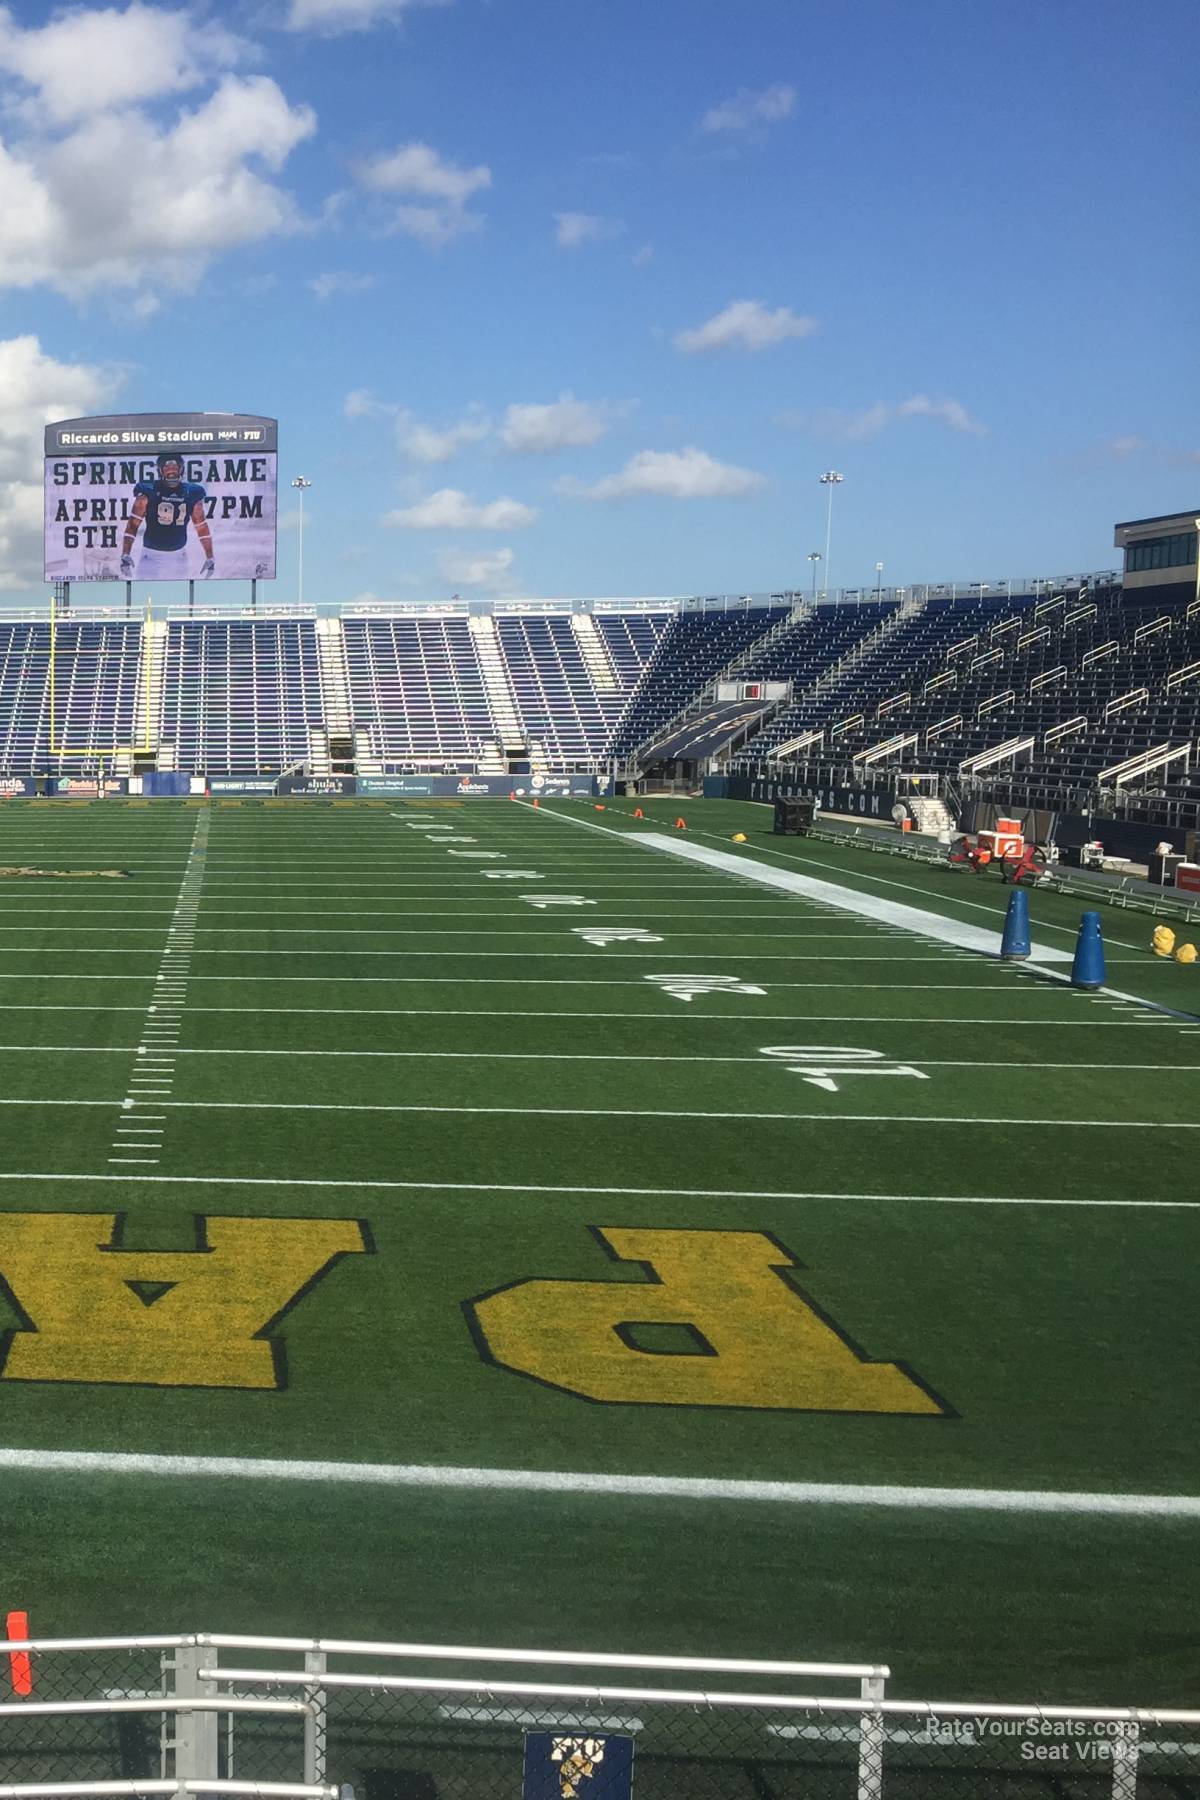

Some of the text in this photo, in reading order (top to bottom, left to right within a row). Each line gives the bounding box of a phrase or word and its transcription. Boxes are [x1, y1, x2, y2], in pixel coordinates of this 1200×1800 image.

[61, 429, 119, 445] Riccardo
[122, 429, 155, 443] Silva
[158, 429, 214, 442] Stadium
[243, 431, 261, 440] FIU
[53, 458, 267, 486] SPRING GAME
[55, 495, 263, 522] APRIL 7PM
[157, 501, 187, 526] 91
[64, 525, 118, 549] 6TH
[758, 1045, 932, 1079] 10
